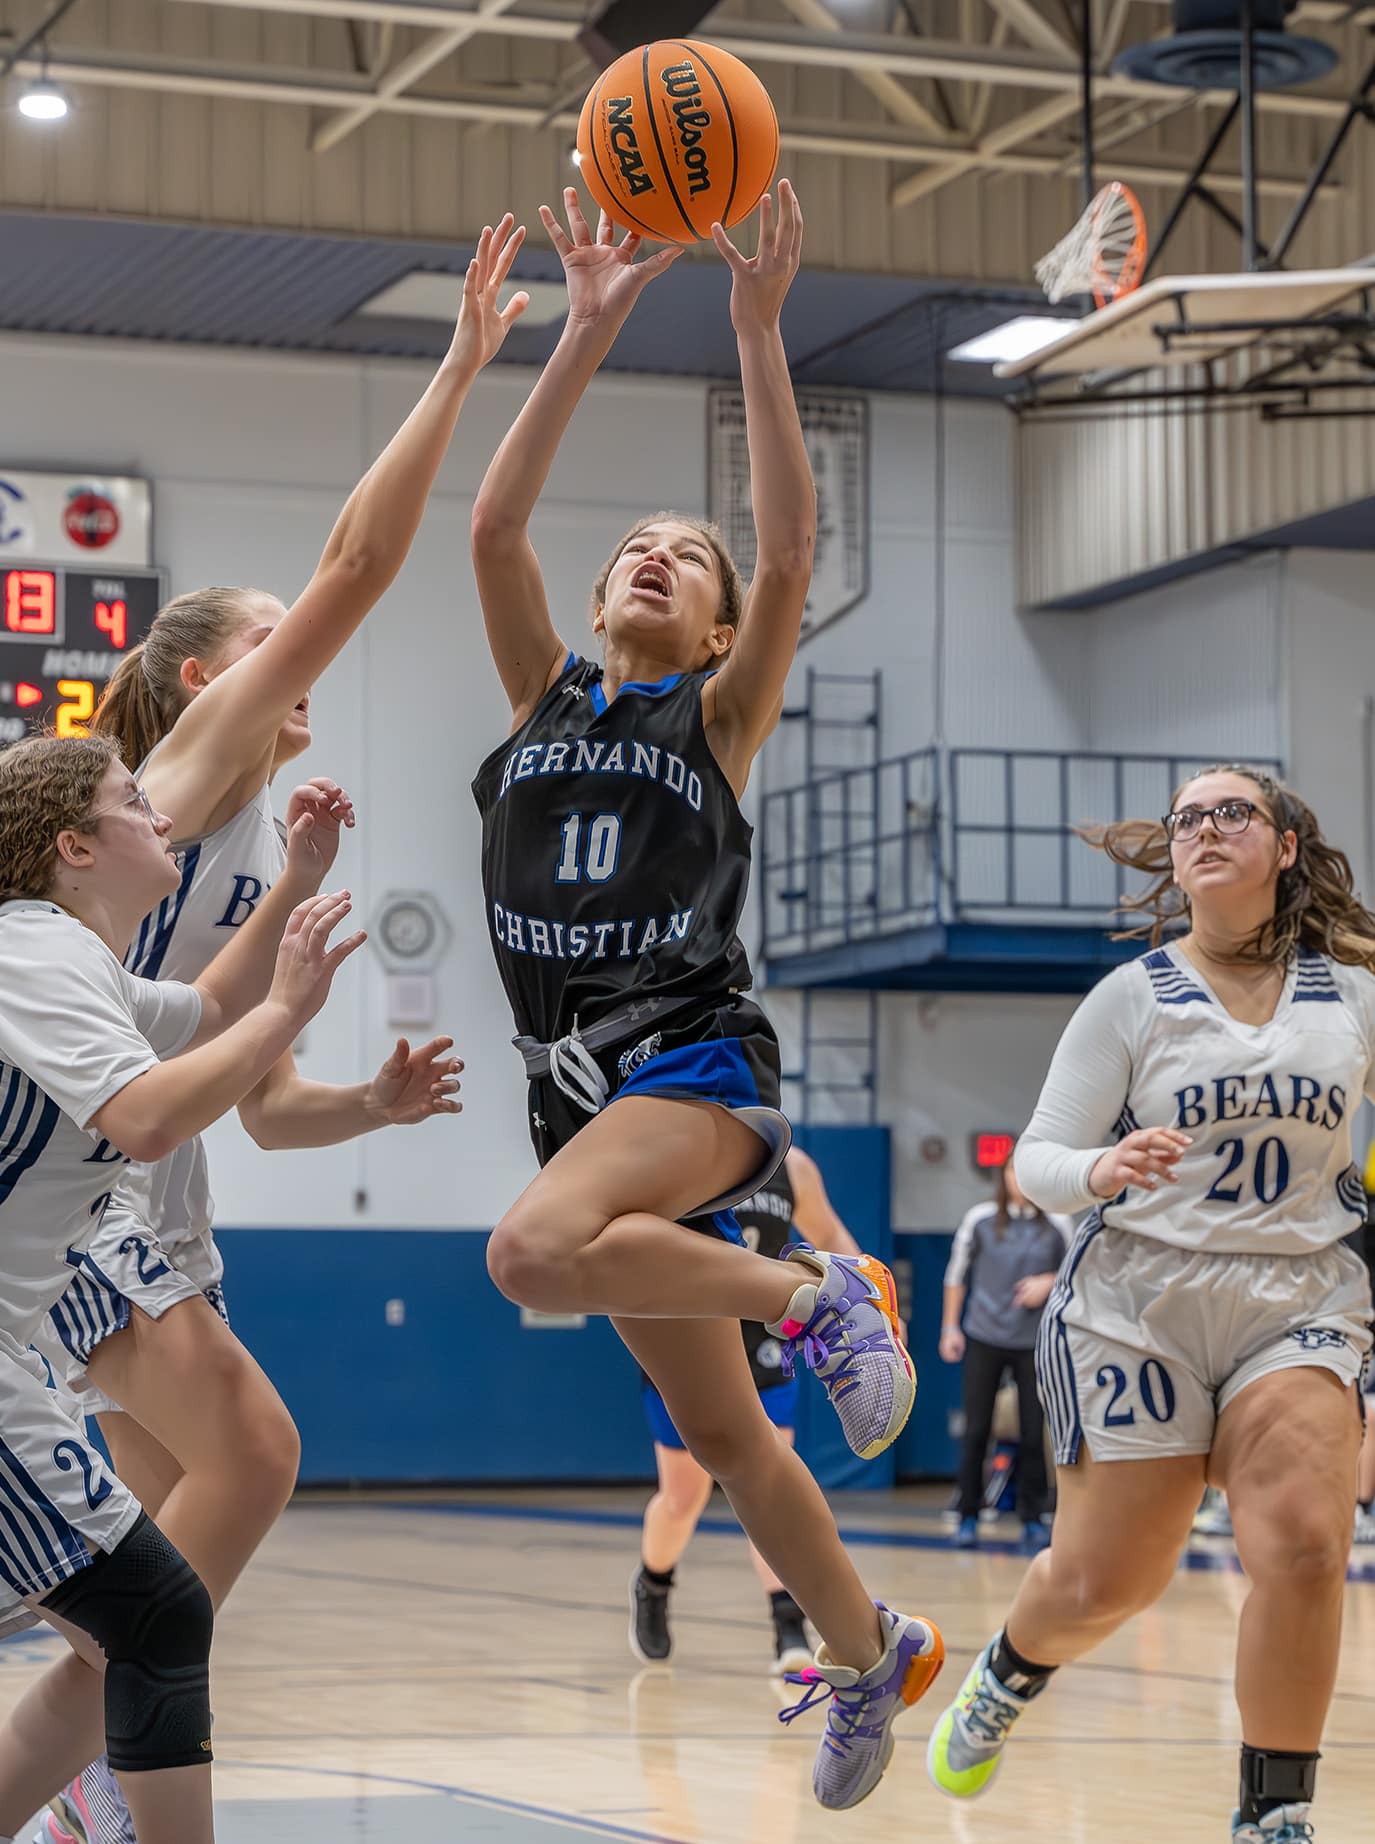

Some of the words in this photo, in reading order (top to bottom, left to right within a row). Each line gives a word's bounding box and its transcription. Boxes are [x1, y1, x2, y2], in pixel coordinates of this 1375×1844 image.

[607, 96, 654, 197] NCAA
[661, 60, 711, 197] Wilson
[6, 570, 55, 634] 13
[95, 600, 127, 649] 4
[42, 651, 116, 679] HOM
[498, 739, 703, 811] HERNANDO
[555, 811, 623, 883] 10
[494, 902, 695, 961] CHRISTIAN
[1174, 1072, 1347, 1131] BEARS
[1205, 1136, 1290, 1204] 20
[118, 1236, 171, 1286] 2
[1096, 1358, 1176, 1428] 20
[52, 1439, 114, 1512] 2
